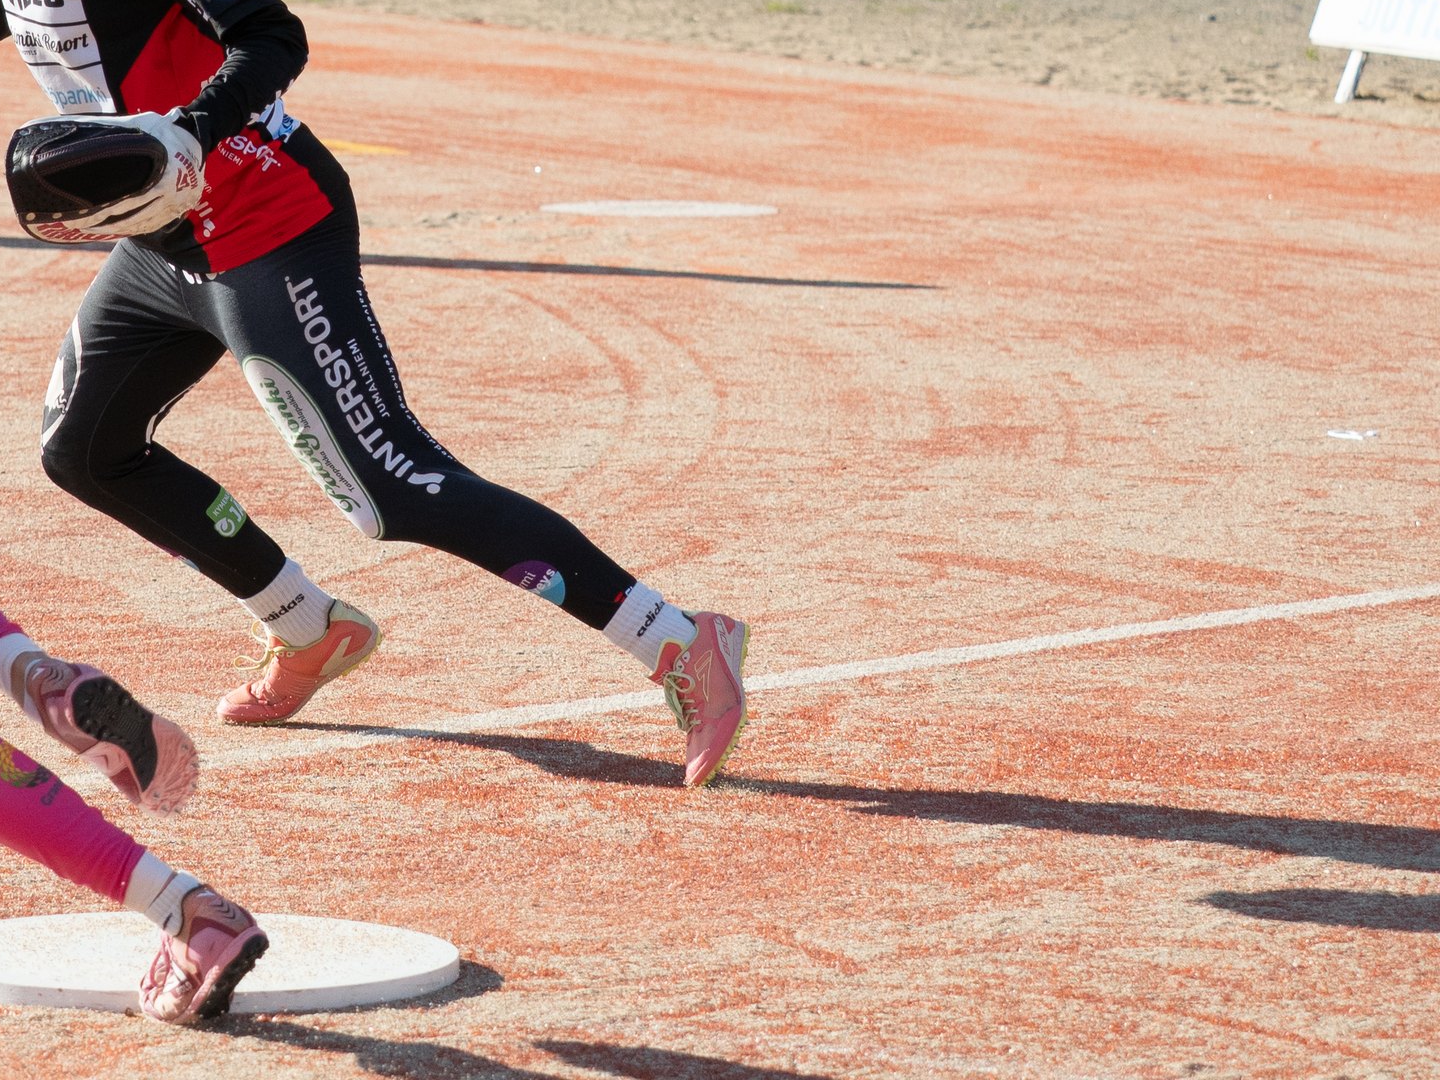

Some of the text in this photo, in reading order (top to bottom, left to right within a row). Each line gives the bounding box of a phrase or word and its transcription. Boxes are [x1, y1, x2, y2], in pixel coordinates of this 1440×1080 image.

[42, 32, 89, 53] Resort
[287, 276, 413, 478] INTERSPORT
[347, 338, 390, 417] JUMALNIEMI
[285, 390, 354, 493] Taukopaikka Juhlapaikka
[261, 592, 305, 623] adidas
[637, 599, 666, 638] adida
